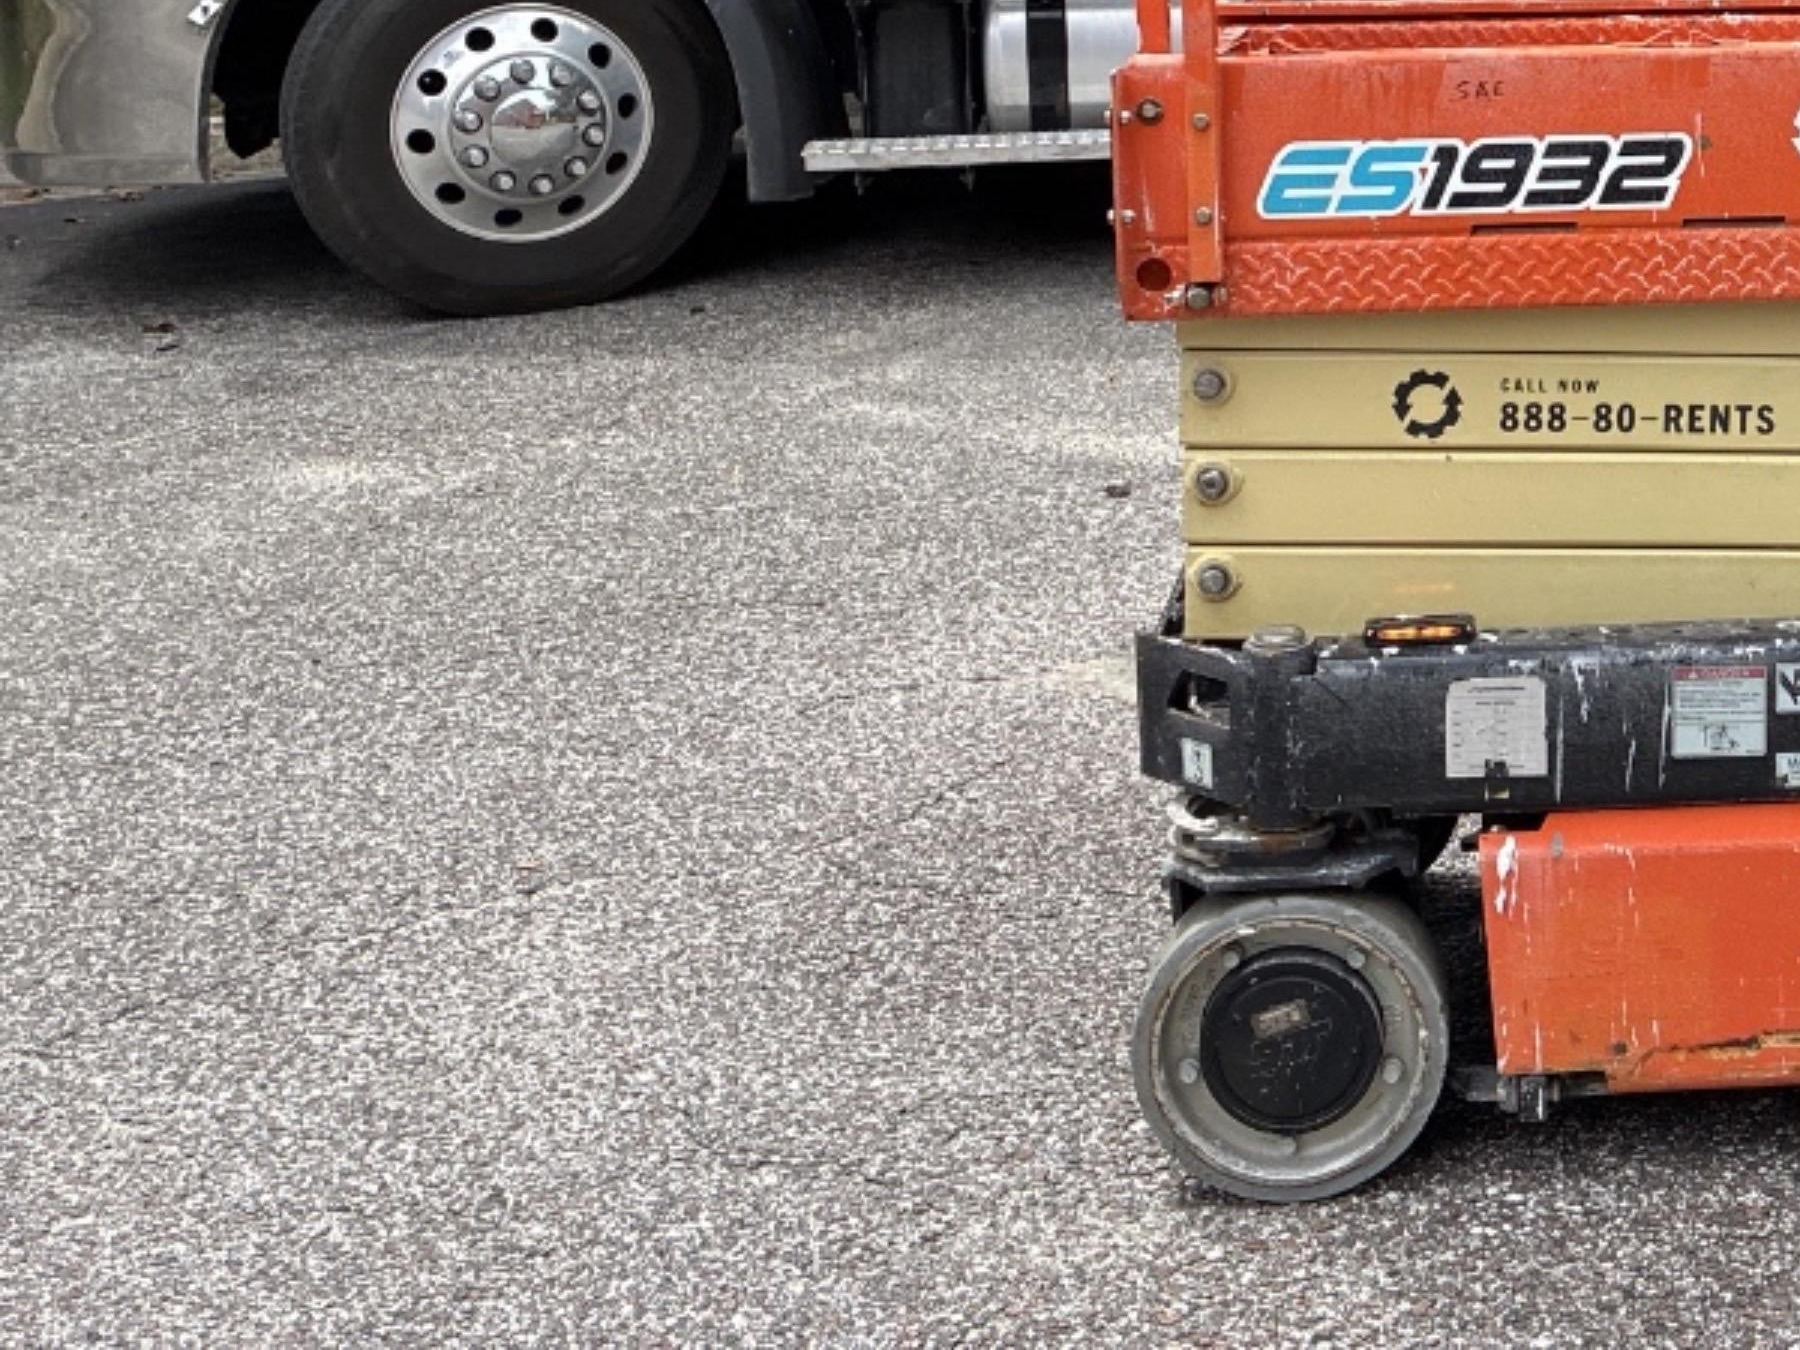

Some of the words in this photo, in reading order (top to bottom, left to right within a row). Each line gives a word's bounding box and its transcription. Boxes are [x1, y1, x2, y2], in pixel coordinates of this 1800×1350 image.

[1261, 136, 1688, 216] ES1932
[1500, 378, 1547, 392] CALL
[1557, 379, 1599, 393] NOW
[1499, 402, 1776, 435] 888-80-RENTS
